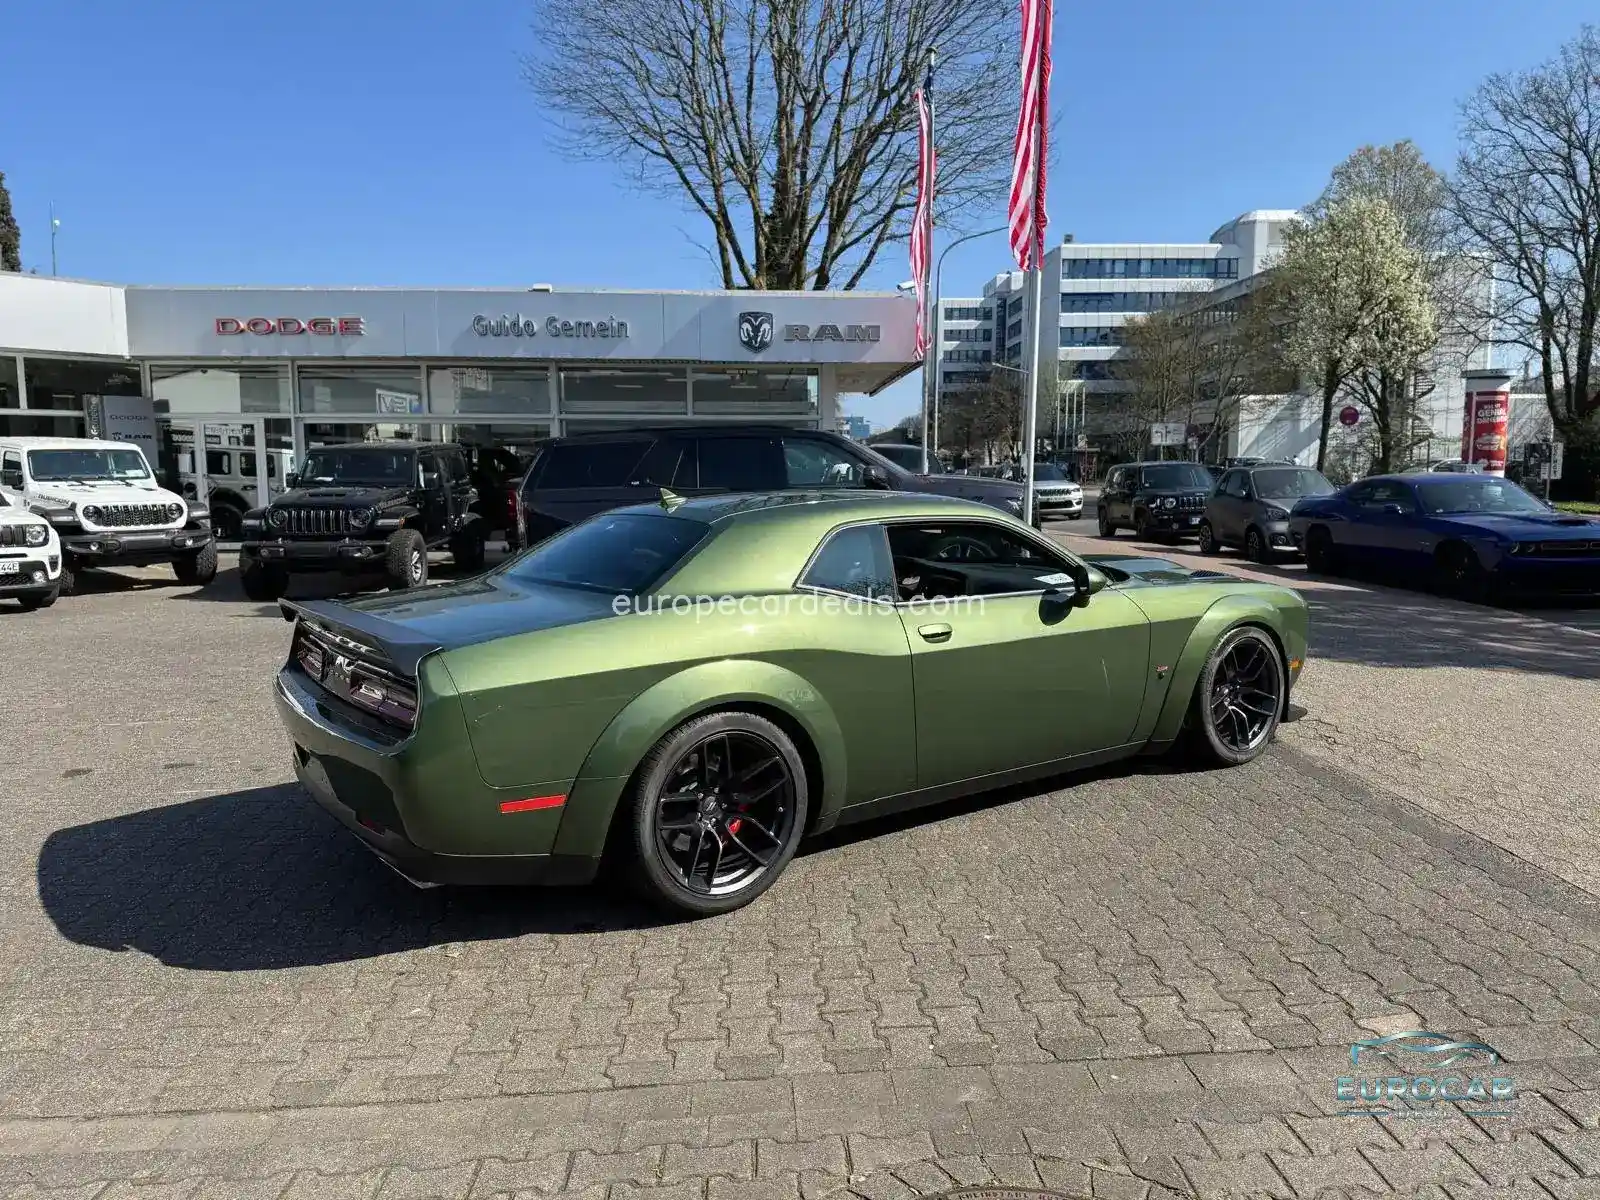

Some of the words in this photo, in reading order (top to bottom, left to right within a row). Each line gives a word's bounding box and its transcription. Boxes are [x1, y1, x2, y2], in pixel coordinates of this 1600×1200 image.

[215, 317, 365, 336] DODGE
[473, 313, 537, 338] Guido
[545, 314, 630, 339] Gemein
[784, 324, 881, 342] RAM
